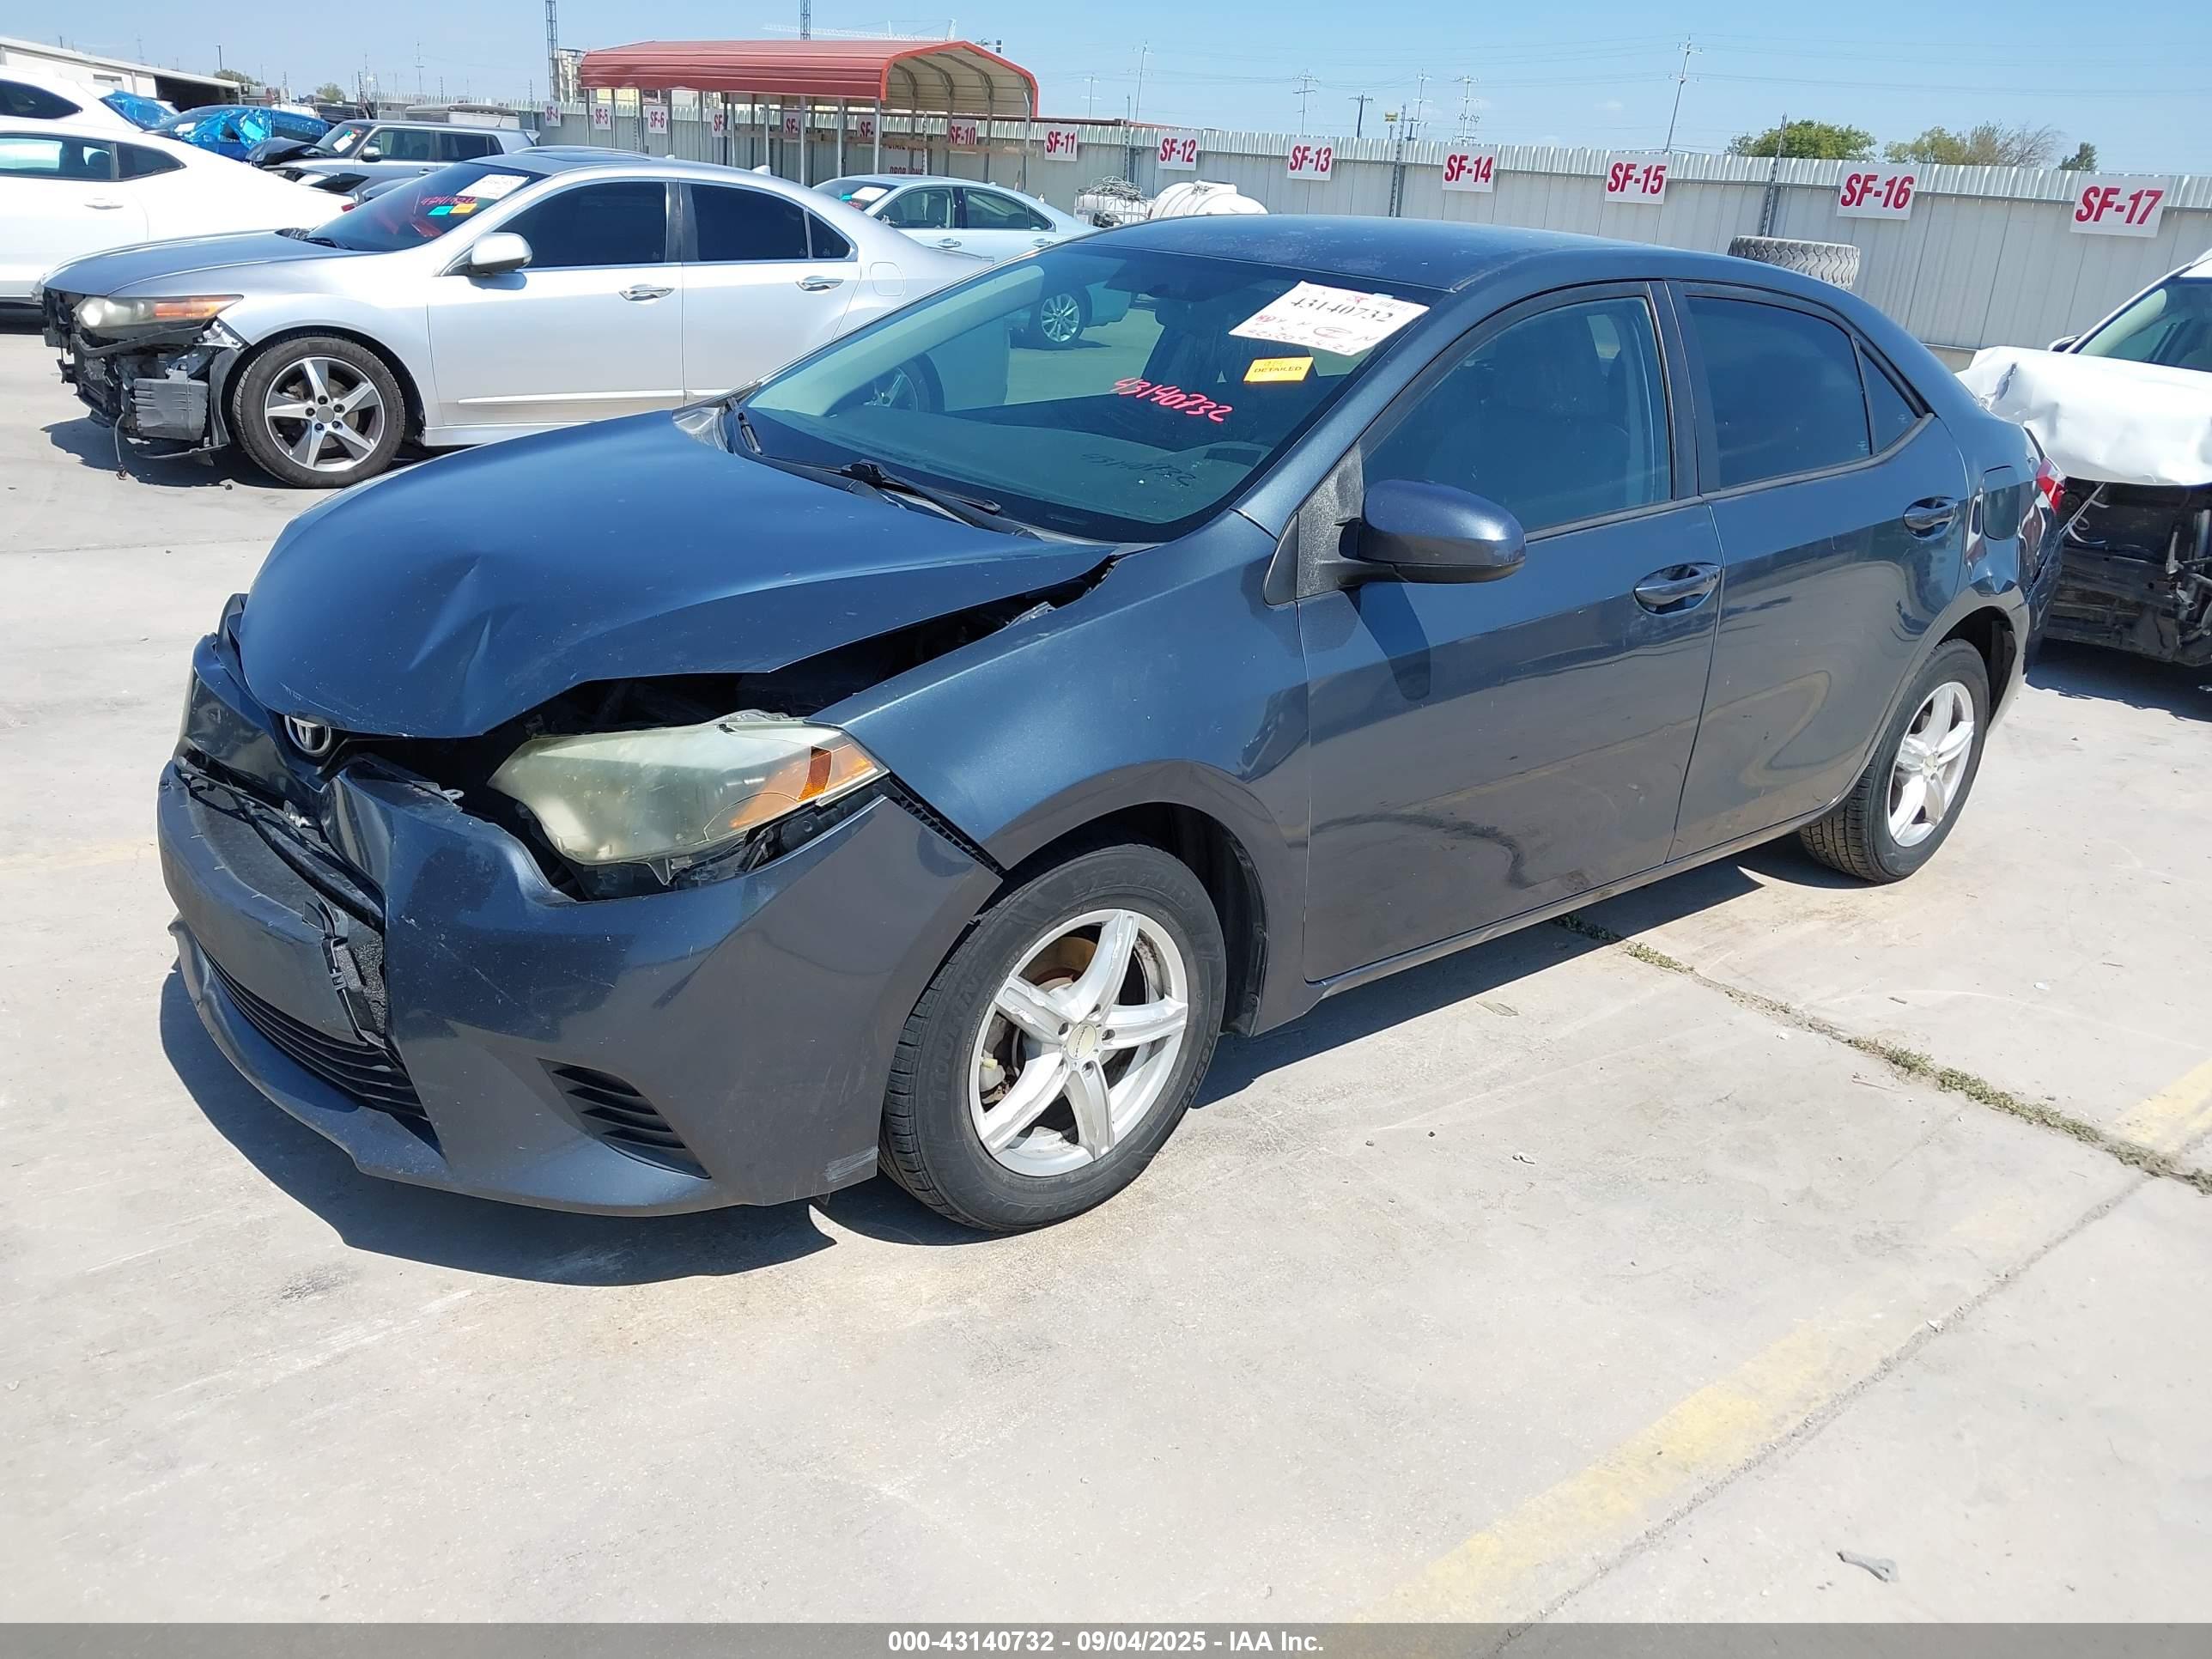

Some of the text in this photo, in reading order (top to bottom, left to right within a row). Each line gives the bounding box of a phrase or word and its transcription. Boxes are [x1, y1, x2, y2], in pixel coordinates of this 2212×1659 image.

[546, 106, 558, 121] SF-4
[595, 108, 608, 125] SF-5
[649, 111, 665, 128] SF-6
[786, 118, 799, 133] SF-
[860, 121, 874, 137] SF-
[948, 125, 976, 144] SF-10
[1046, 131, 1075, 155] SF-11
[1159, 137, 1196, 163] SF-12
[1289, 145, 1332, 173] SF-13
[1444, 154, 1493, 184] SF-14
[1607, 161, 1667, 195] SF-15
[1840, 173, 1915, 210] SF-16
[2075, 185, 2165, 225] SF-17
[1291, 297, 1394, 323] 43140732
[1109, 377, 1234, 422] 43140732
